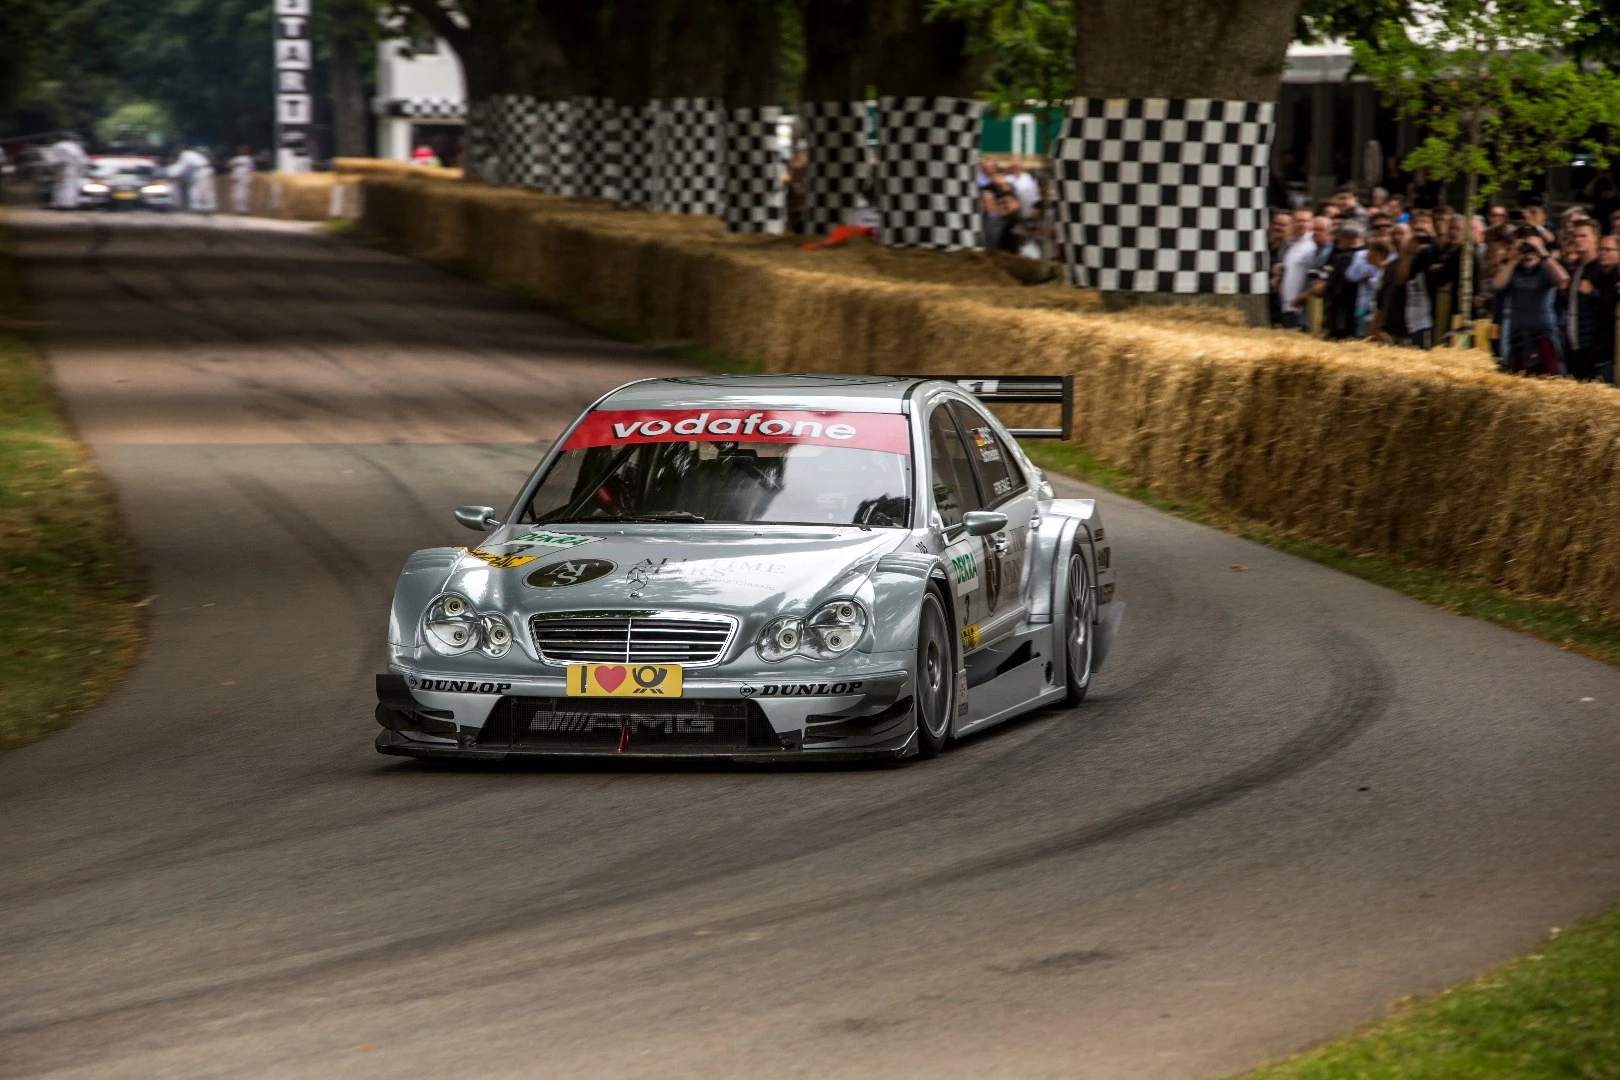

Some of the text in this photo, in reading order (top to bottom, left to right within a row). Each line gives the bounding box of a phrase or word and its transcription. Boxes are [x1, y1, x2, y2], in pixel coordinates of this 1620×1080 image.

[612, 412, 857, 440] vodafone
[513, 532, 589, 546] DEKRA
[952, 552, 978, 585] DEKRA
[420, 678, 512, 693] DUNLOP
[760, 681, 863, 695] DUNLOP
